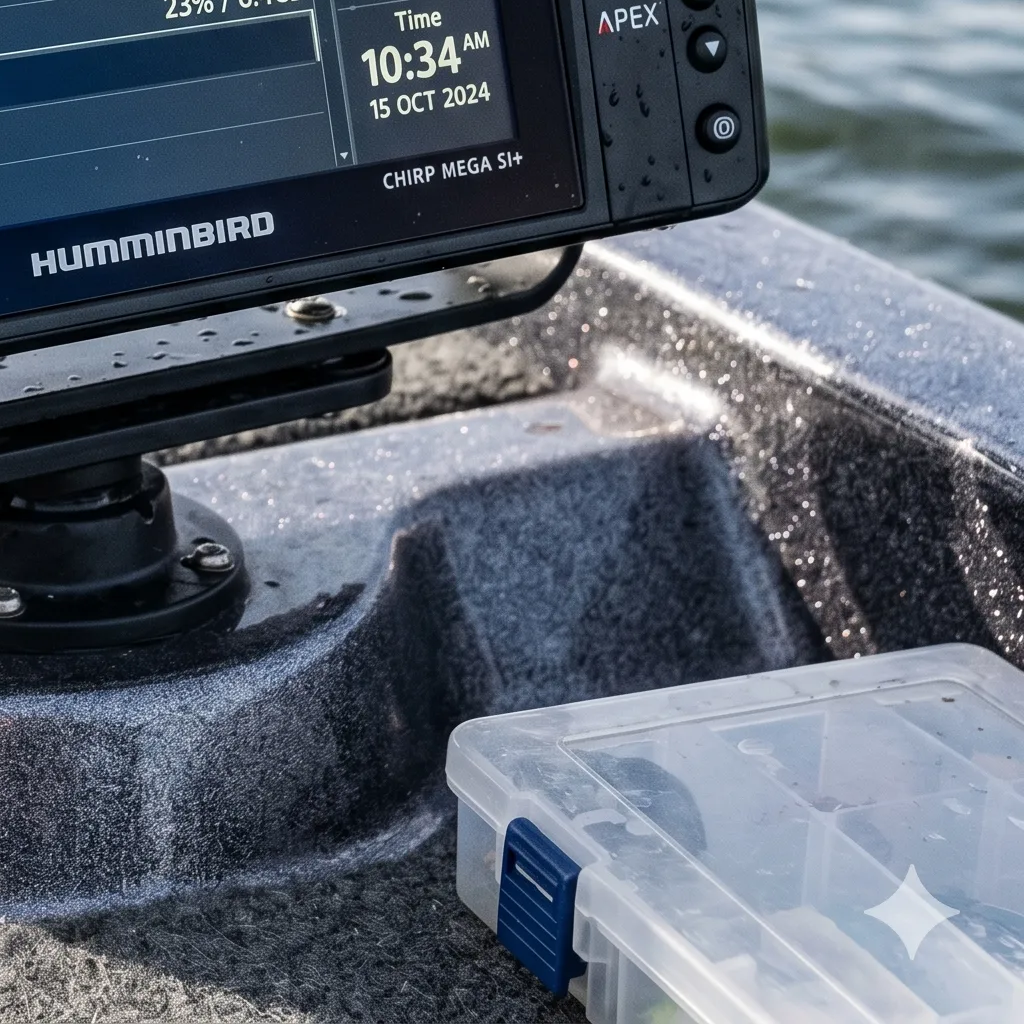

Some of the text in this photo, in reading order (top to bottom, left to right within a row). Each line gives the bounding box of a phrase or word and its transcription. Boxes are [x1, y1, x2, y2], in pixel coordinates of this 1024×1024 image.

[394, 10, 441, 31] Time
[599, 3, 658, 33] APEX
[362, 31, 489, 86] 10:34 AM
[370, 82, 490, 119] 15 OCT 2024
[383, 152, 522, 189] CHIRP MEGA SI+
[31, 212, 274, 276] HUMMINBIRD
